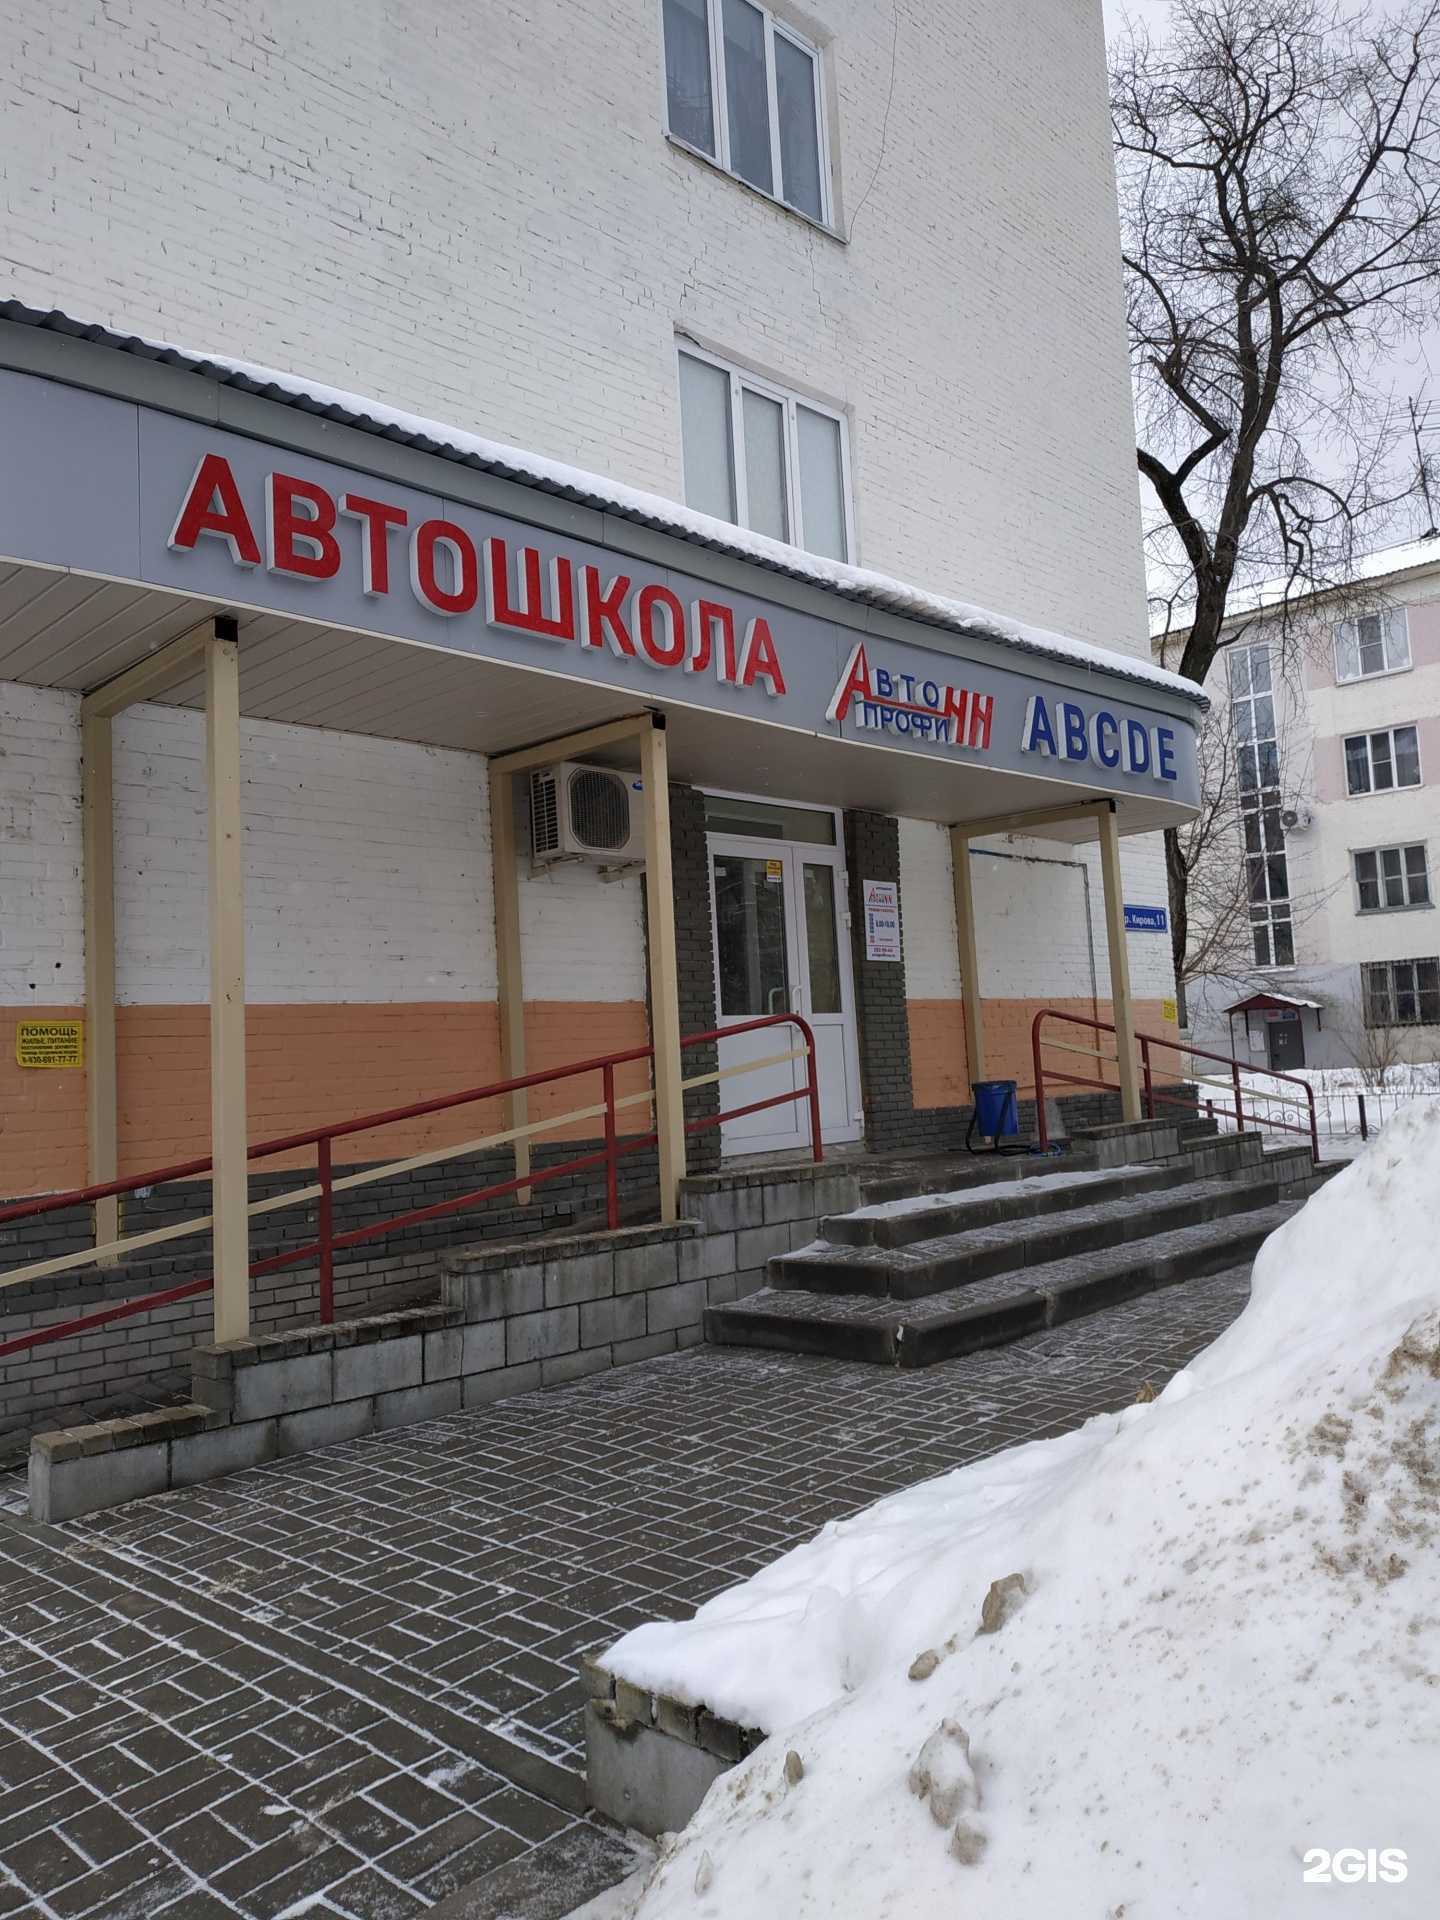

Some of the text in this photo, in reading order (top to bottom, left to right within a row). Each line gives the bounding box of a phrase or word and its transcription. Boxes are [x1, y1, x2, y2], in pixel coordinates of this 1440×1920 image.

[167, 453, 787, 697] АВТОШКОЛА
[855, 700, 950, 742] ПРОФИ
[1021, 695, 1177, 782] ABCDE
[21, 1028, 78, 1037] ПОМОЩЬ
